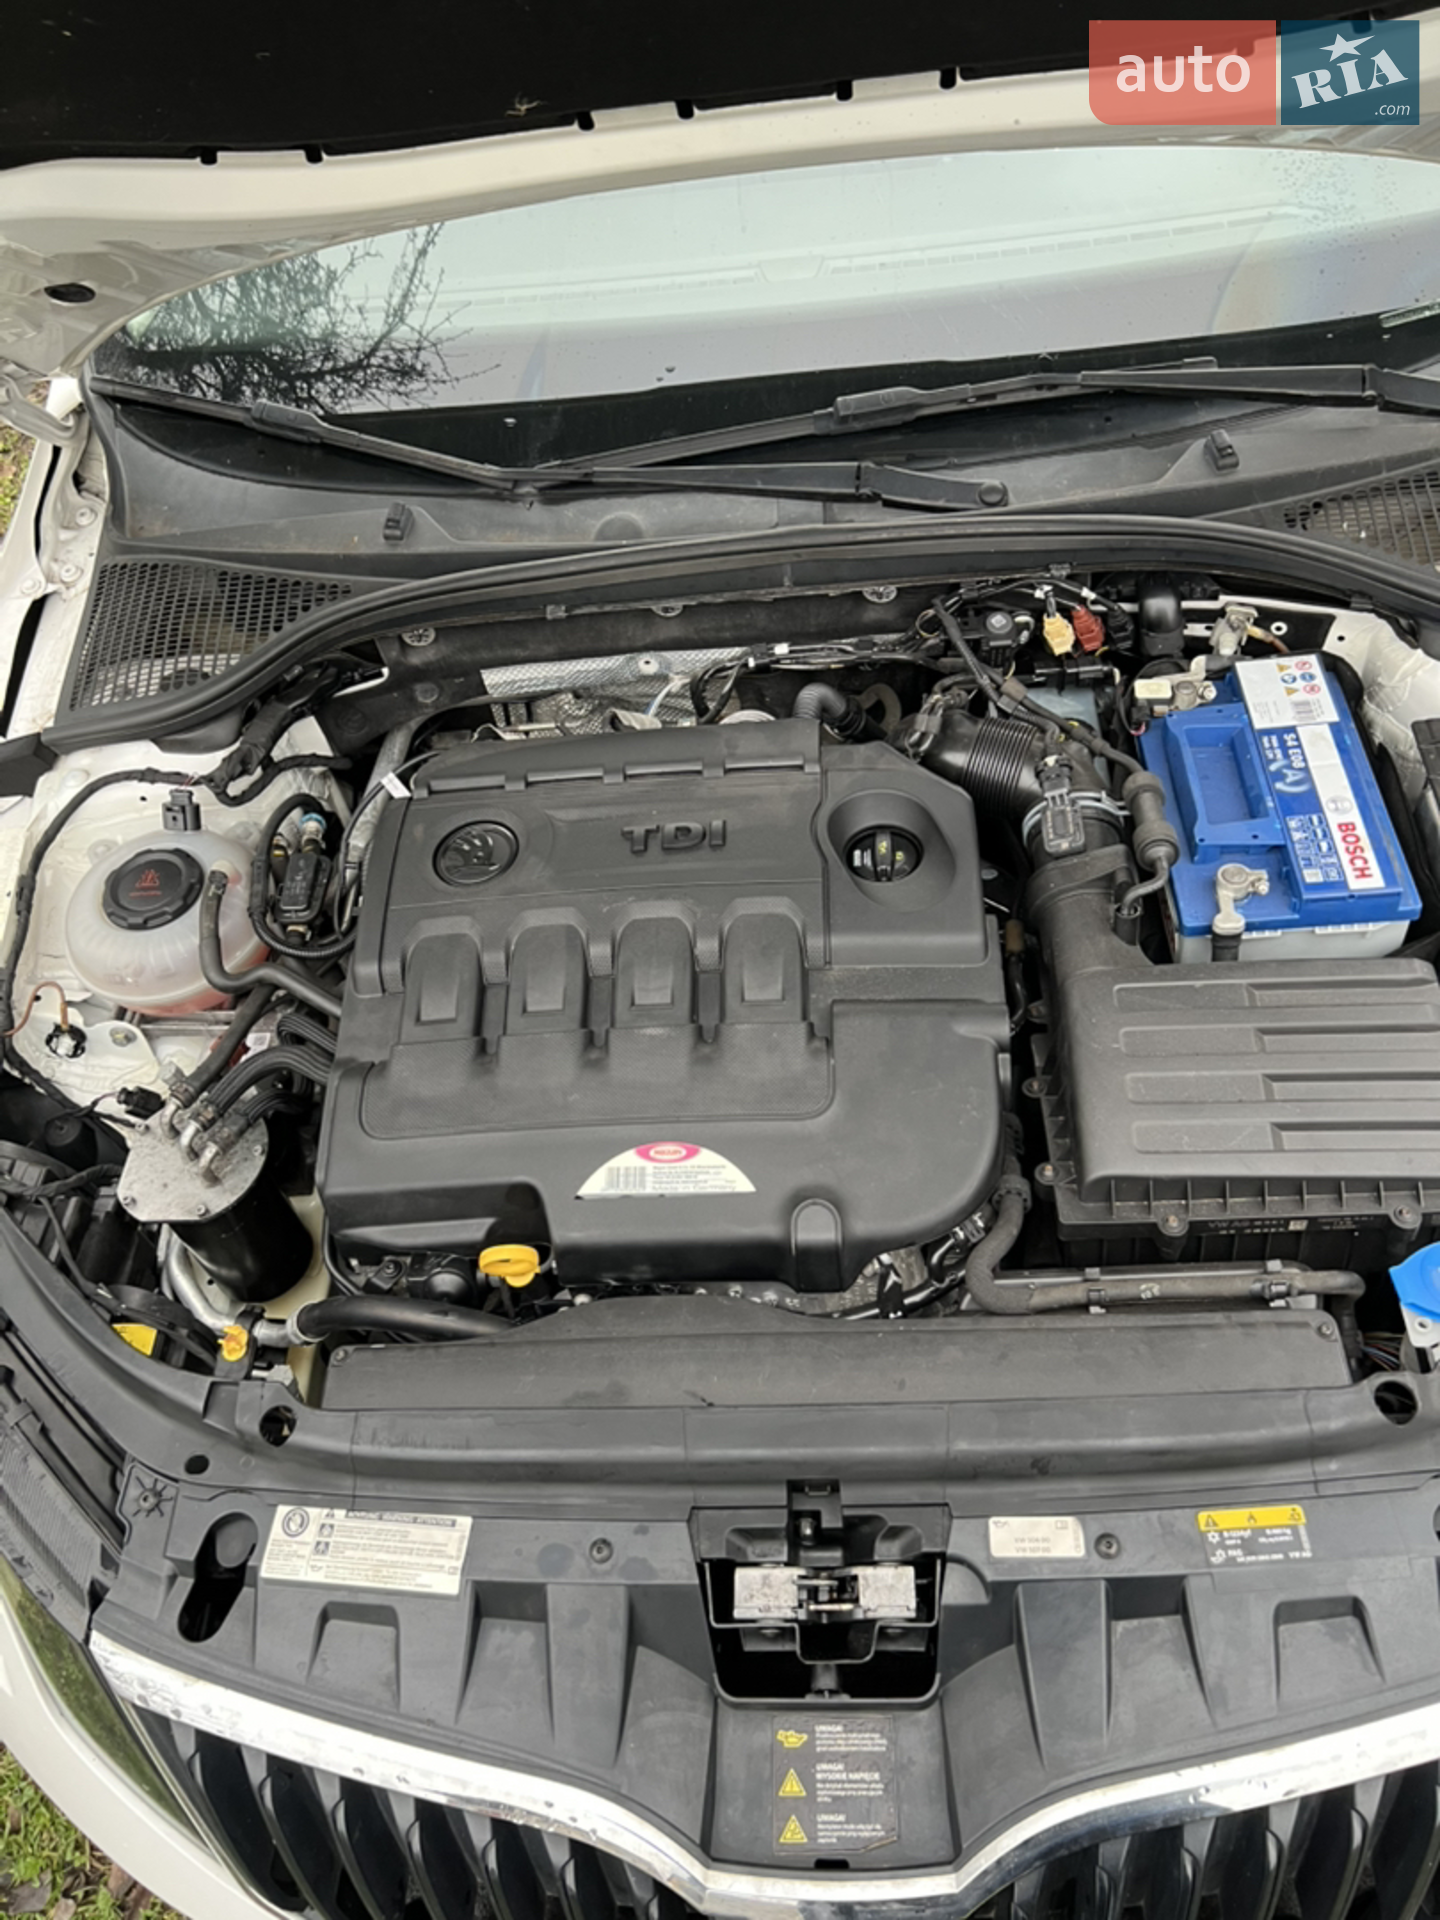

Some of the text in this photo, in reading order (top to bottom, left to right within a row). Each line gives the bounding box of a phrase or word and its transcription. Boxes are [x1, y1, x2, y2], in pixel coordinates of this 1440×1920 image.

[1283, 733, 1299, 747] S4
[621, 819, 727, 854] TDI
[1337, 821, 1374, 879] BOSCH
